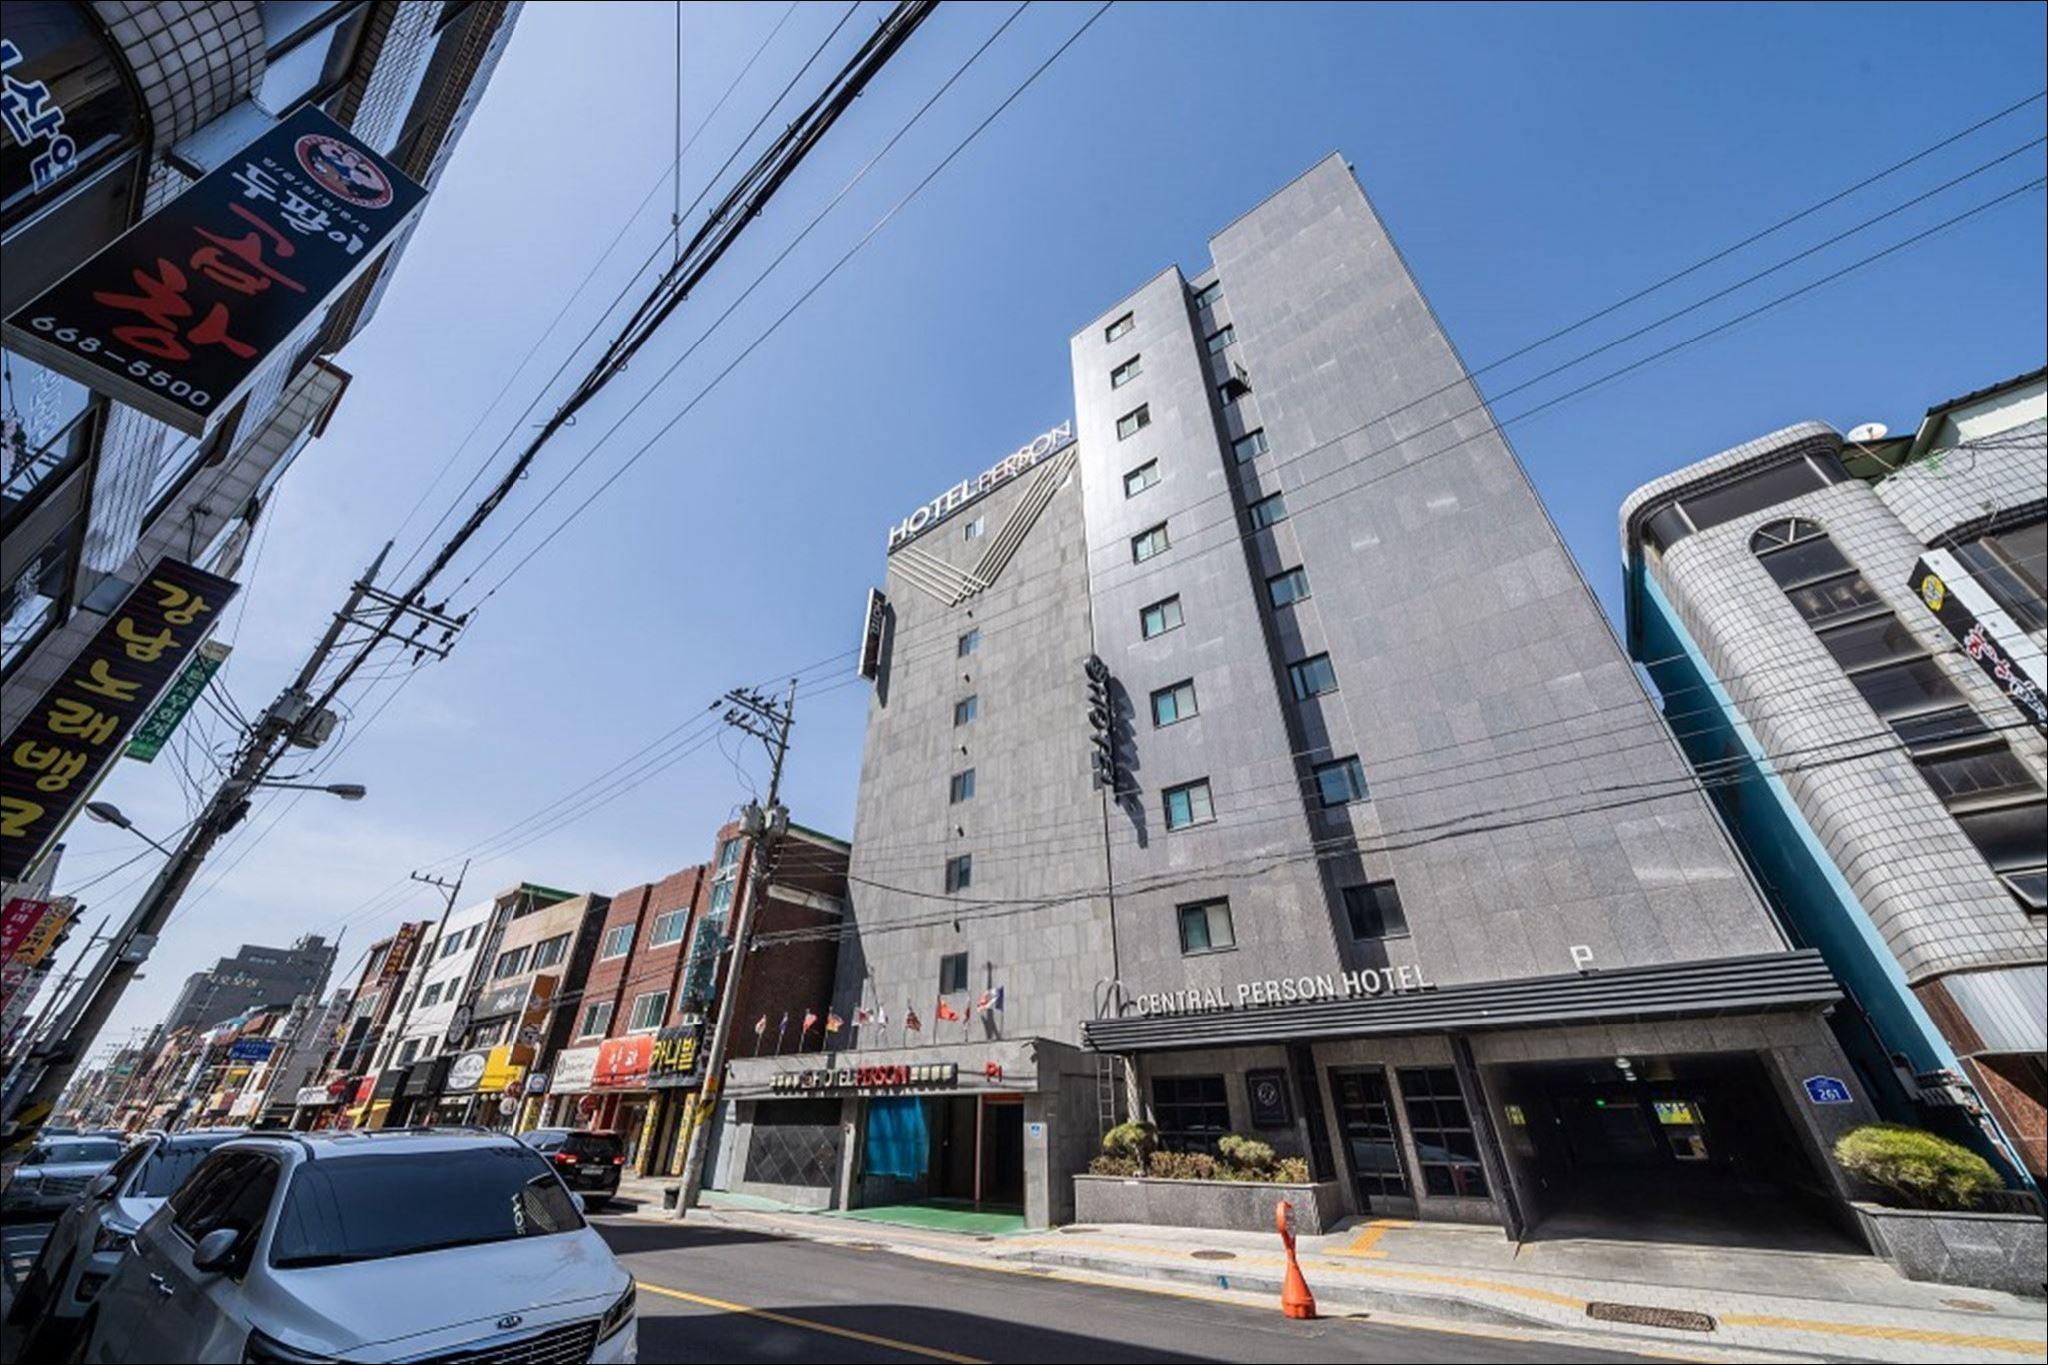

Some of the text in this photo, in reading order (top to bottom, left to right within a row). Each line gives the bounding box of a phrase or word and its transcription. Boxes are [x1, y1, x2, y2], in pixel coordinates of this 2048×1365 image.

[31, 316, 211, 407] 668-5500
[889, 419, 1072, 546] HOTEL PERSON
[1570, 945, 1593, 972] P
[1137, 964, 1435, 1015] CENTRAL PERSON HOTEL
[1818, 1088, 1841, 1101] 261
